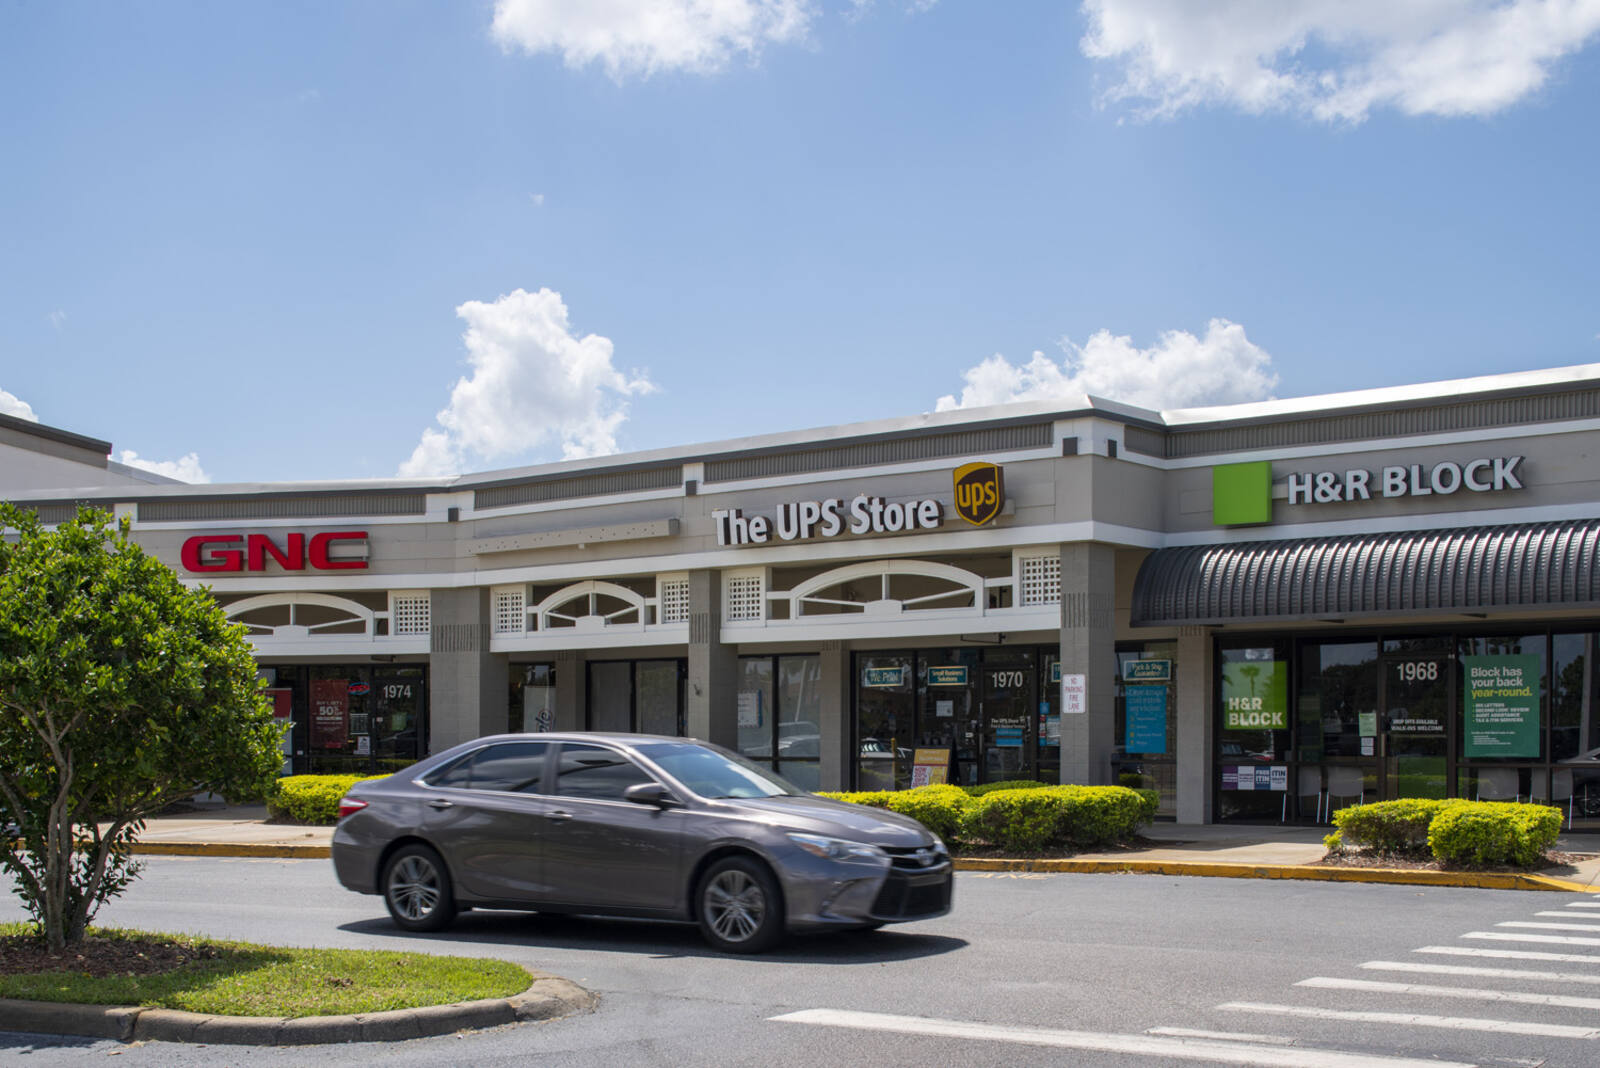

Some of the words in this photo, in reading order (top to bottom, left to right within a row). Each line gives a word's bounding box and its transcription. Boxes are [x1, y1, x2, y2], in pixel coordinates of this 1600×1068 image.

[1288, 468, 1371, 505] H&R
[1383, 456, 1524, 498] BLOCK
[957, 480, 996, 516] ups
[711, 509, 770, 546] The
[776, 498, 844, 541] UPS
[850, 494, 942, 536] Store
[181, 531, 369, 573] GNC
[992, 671, 1023, 688] 1970
[1396, 662, 1438, 681] 1968
[1471, 667, 1500, 677] Block
[1503, 666, 1522, 677] has
[1471, 679, 1495, 689] your
[1496, 677, 1523, 687] back
[383, 684, 412, 699] 1974
[1471, 686, 1533, 700] year-round.
[1229, 697, 1263, 711] H&R
[1229, 712, 1283, 726] BLOCK
